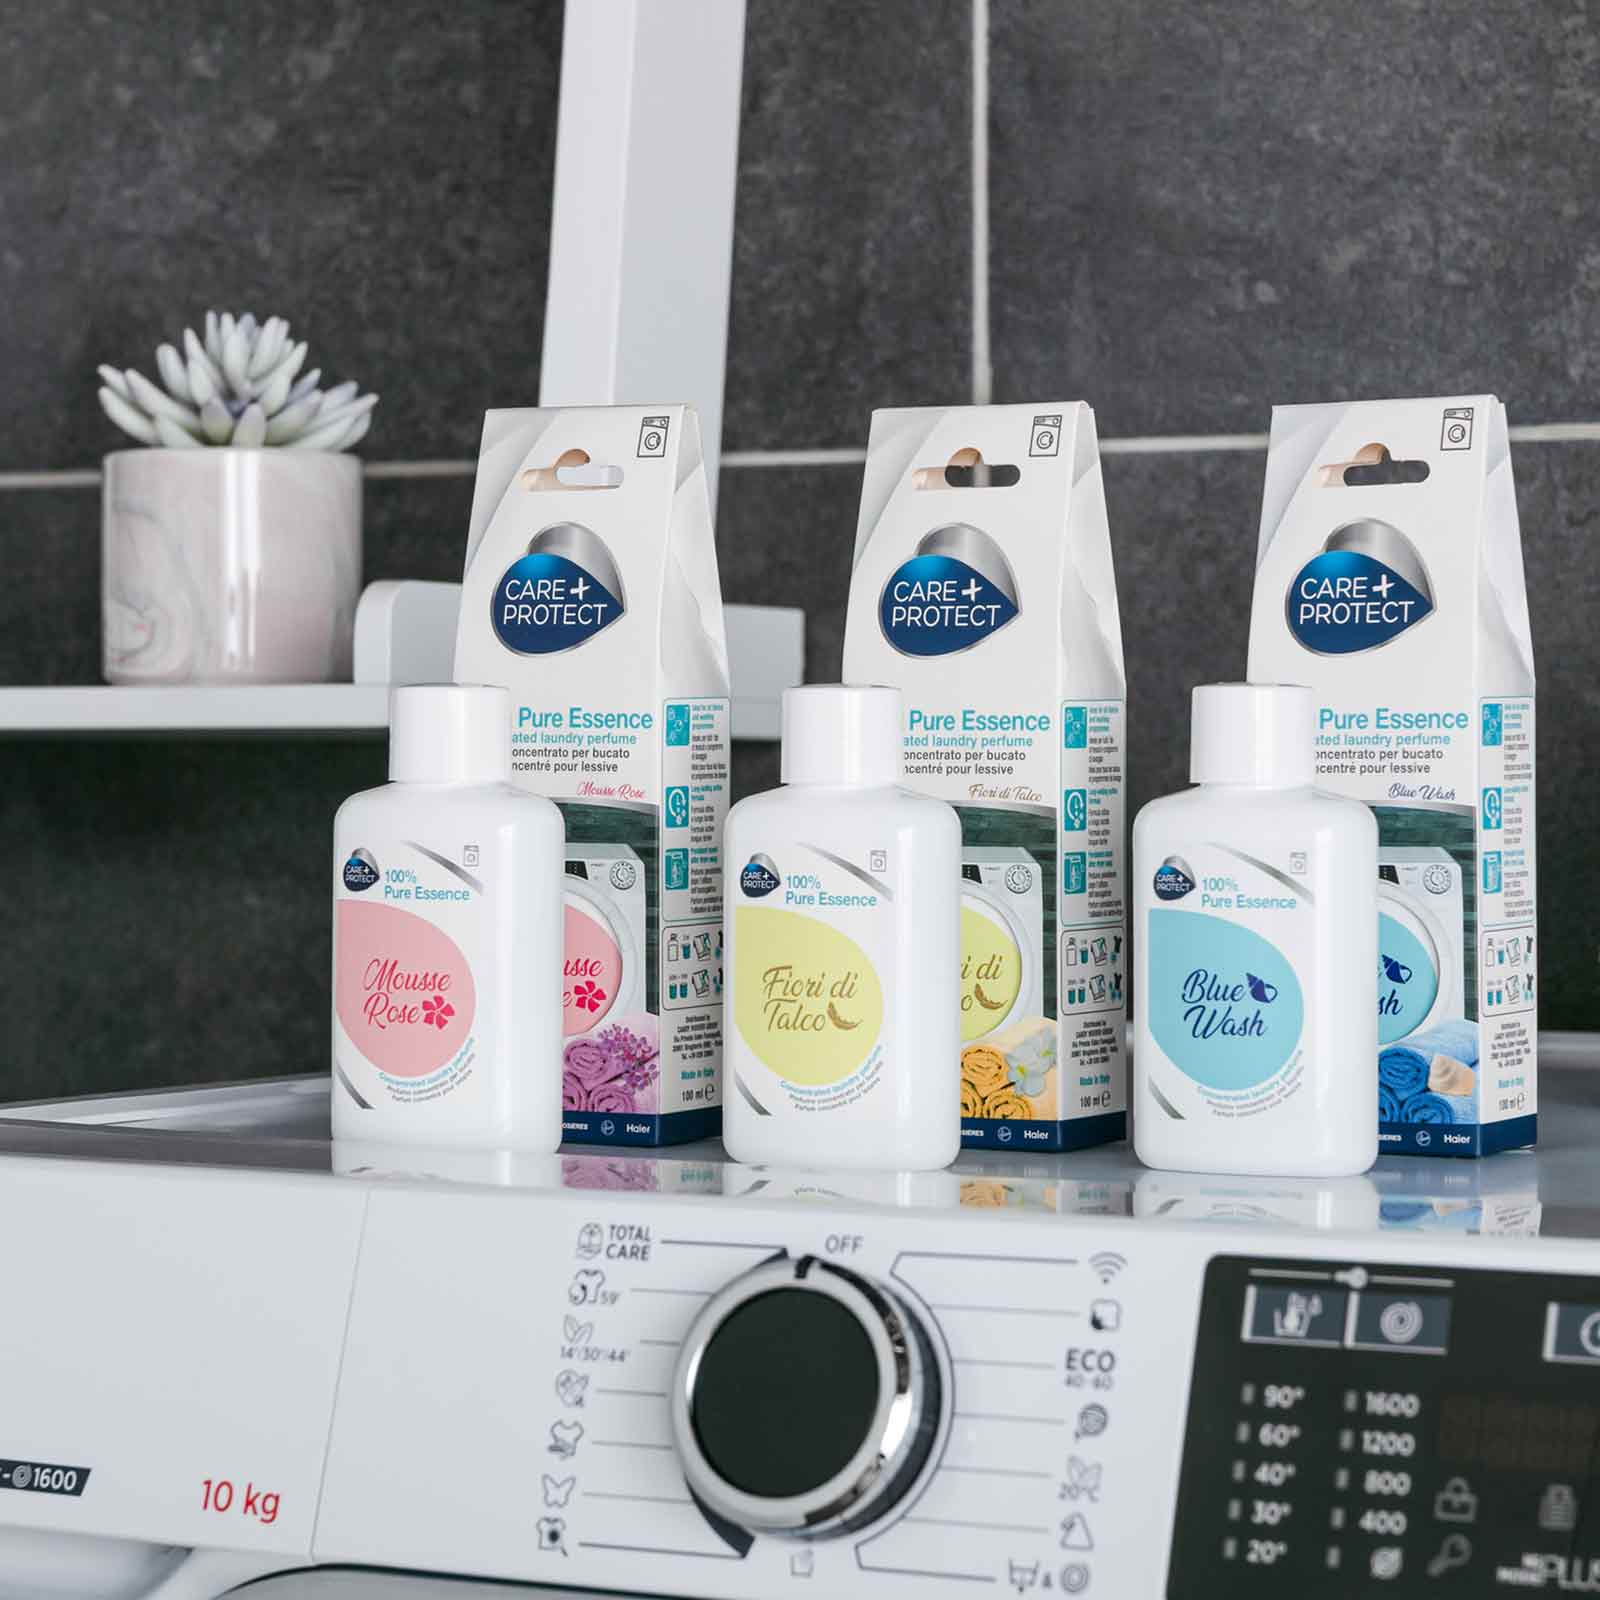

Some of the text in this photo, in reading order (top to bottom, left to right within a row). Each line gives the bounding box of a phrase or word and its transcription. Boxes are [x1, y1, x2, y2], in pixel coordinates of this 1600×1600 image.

[503, 603, 608, 625] PROTECT
[892, 605, 1001, 627] PROTECT
[1299, 600, 1416, 625] PROTECT
[518, 707, 653, 729] Pure Essence
[909, 710, 1050, 732] Pure Essence
[1319, 707, 1469, 729] Pure Essence
[541, 732, 583, 746] laundry
[587, 733, 636, 747] perfume
[932, 735, 977, 749] laundry
[981, 736, 1033, 750] perfume
[1344, 733, 1391, 748] laundry
[1395, 734, 1451, 748] perfume
[572, 749, 589, 760] per
[592, 748, 630, 759] bucato
[965, 752, 982, 763] per
[987, 750, 1026, 761] bucato
[1379, 751, 1398, 762] per
[1402, 749, 1444, 760] bucato
[554, 763, 578, 774] pour
[581, 761, 618, 772] lessive
[946, 766, 971, 777] pour
[975, 764, 1014, 775] lessive
[1359, 765, 1386, 776] pour
[1390, 763, 1430, 774] lessive
[968, 784, 997, 800] Fiori
[1013, 786, 1042, 802] Talco
[1388, 783, 1456, 801] Blue Wash
[345, 874, 376, 884] PROTECT
[384, 870, 417, 884] 100%
[743, 880, 775, 890] PROTECT
[785, 875, 822, 890] 100%
[1202, 878, 1238, 892] 100%
[384, 885, 470, 901] Pure Essence
[1156, 882, 1191, 892] PROTECT
[785, 891, 877, 907] Pure Essence
[1201, 894, 1297, 909] Pure Essence
[363, 958, 450, 993] Mousse
[977, 954, 1003, 981] di
[762, 965, 858, 999] Fiori di
[1182, 968, 1247, 1004] Blue
[363, 992, 420, 1029] Rose
[763, 998, 827, 1032] Talco
[1183, 1004, 1268, 1039] Wash
[682, 1089, 694, 1102] 100
[1080, 1096, 1091, 1109] 100
[626, 1123, 650, 1134] Haier
[1024, 1130, 1049, 1140] Haier
[1443, 1134, 1470, 1144] Haier
[608, 1225, 651, 1243] TOTAL
[605, 1244, 650, 1261] CARE
[825, 1235, 864, 1253] OFF
[1065, 1347, 1116, 1373] ECO
[1362, 1430, 1415, 1457] 1200
[34, 1466, 77, 1492] 1600
[1254, 1461, 1296, 1487] 40°
[202, 1479, 280, 1524] 10 kg
[1358, 1508, 1407, 1536] 400
